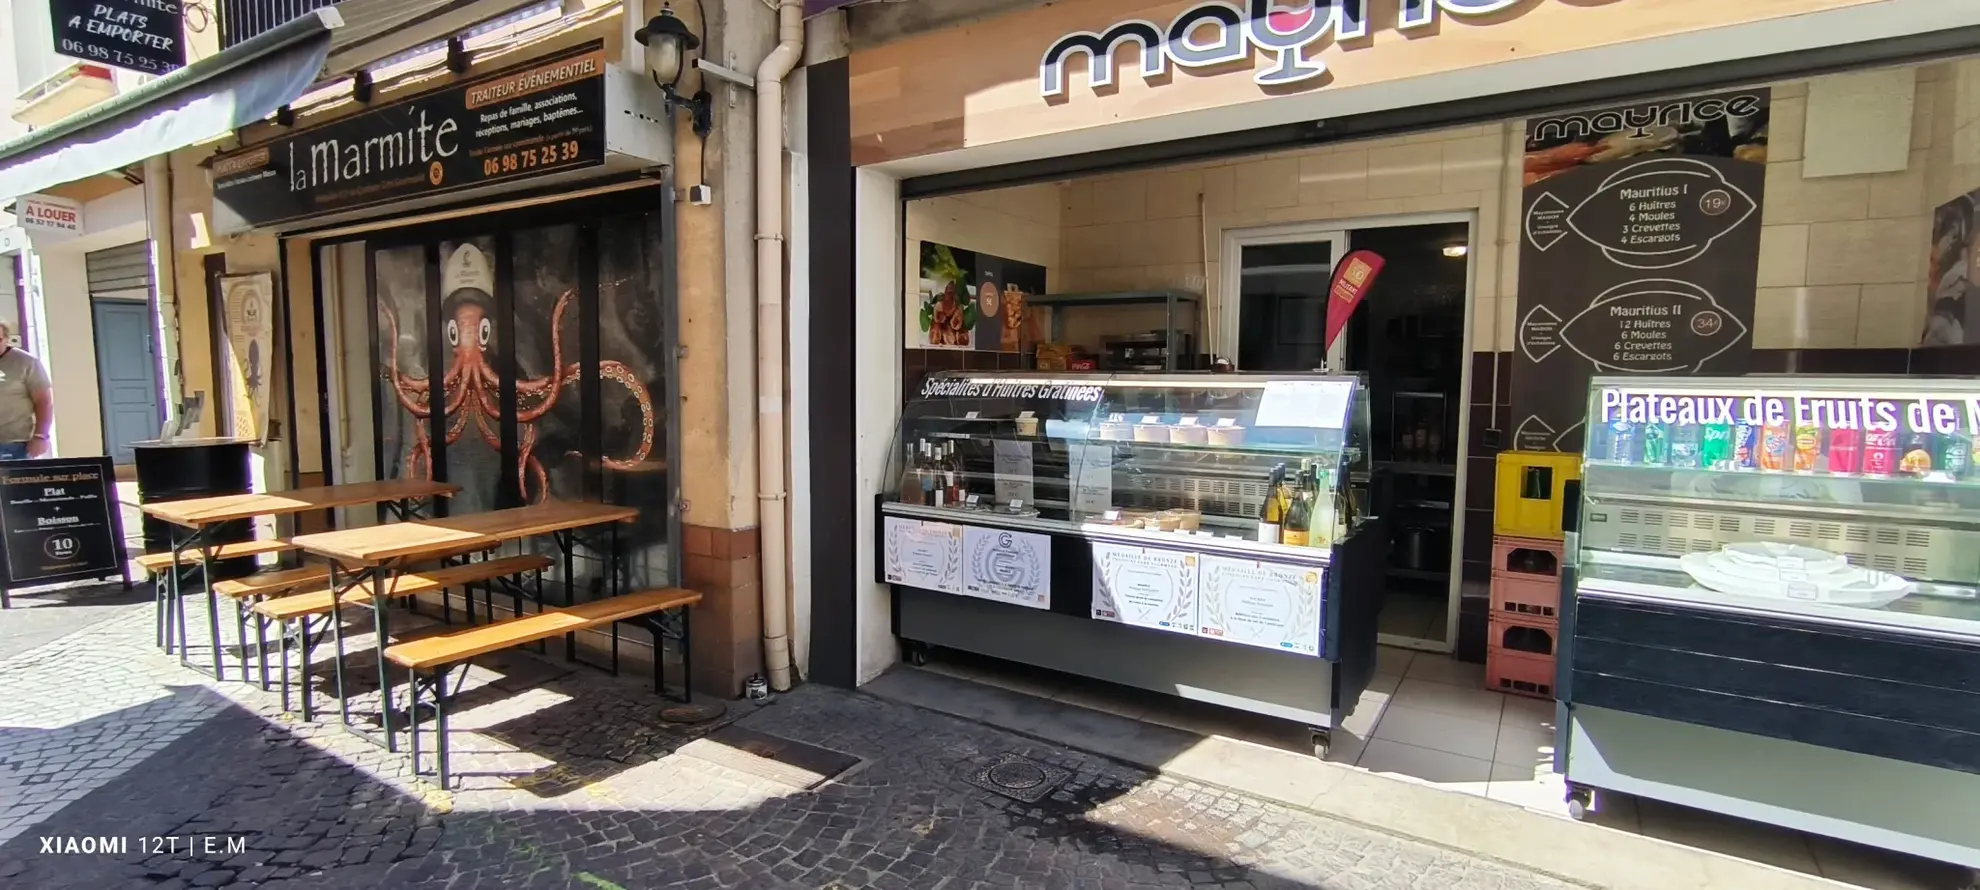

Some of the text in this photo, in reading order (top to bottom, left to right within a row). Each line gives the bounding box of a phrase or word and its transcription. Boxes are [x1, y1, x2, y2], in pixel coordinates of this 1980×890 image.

[94, 4, 148, 28] PLATS
[68, 16, 173, 52] A EMPORTER
[62, 39, 83, 53] 06
[88, 44, 109, 59] 98
[114, 50, 134, 65] 75
[139, 57, 157, 70] 25
[471, 58, 596, 104] TRAITEUR ÉVÉNEMENTIEL
[480, 92, 577, 124] Repas de famille, associations,
[475, 126, 509, 138] réceptions,
[510, 117, 542, 130] mariages,
[484, 140, 579, 176] 06 98 75 25 39
[290, 141, 306, 192] la
[1620, 184, 1688, 200] Mauritius I
[1629, 201, 1677, 211] 6 Huîtres
[37, 208, 76, 223] LOUER
[1629, 212, 1675, 222] 4 Moules
[1622, 223, 1681, 233] 3 Crevettes
[1620, 233, 1681, 244] 4 Escargots
[1610, 304, 1681, 317] Mauritius II
[1620, 320, 1671, 329] 12 Huîtres
[1621, 330, 1667, 339] 6 Moules
[1614, 341, 1672, 350] 6 Crevettes
[1613, 352, 1672, 361] 6 Escargots
[921, 378, 1103, 401] Spécialités d'Huîtres Gratinées
[1601, 389, 1734, 425] Plateaux
[1743, 390, 1785, 427] de
[1796, 392, 1897, 431] Fruits
[1908, 394, 1956, 434] de
[2, 474, 50, 485] Formule
[72, 472, 99, 481] place
[44, 487, 66, 496] Plat
[37, 516, 79, 526] Boisson
[52, 538, 73, 550] 10
